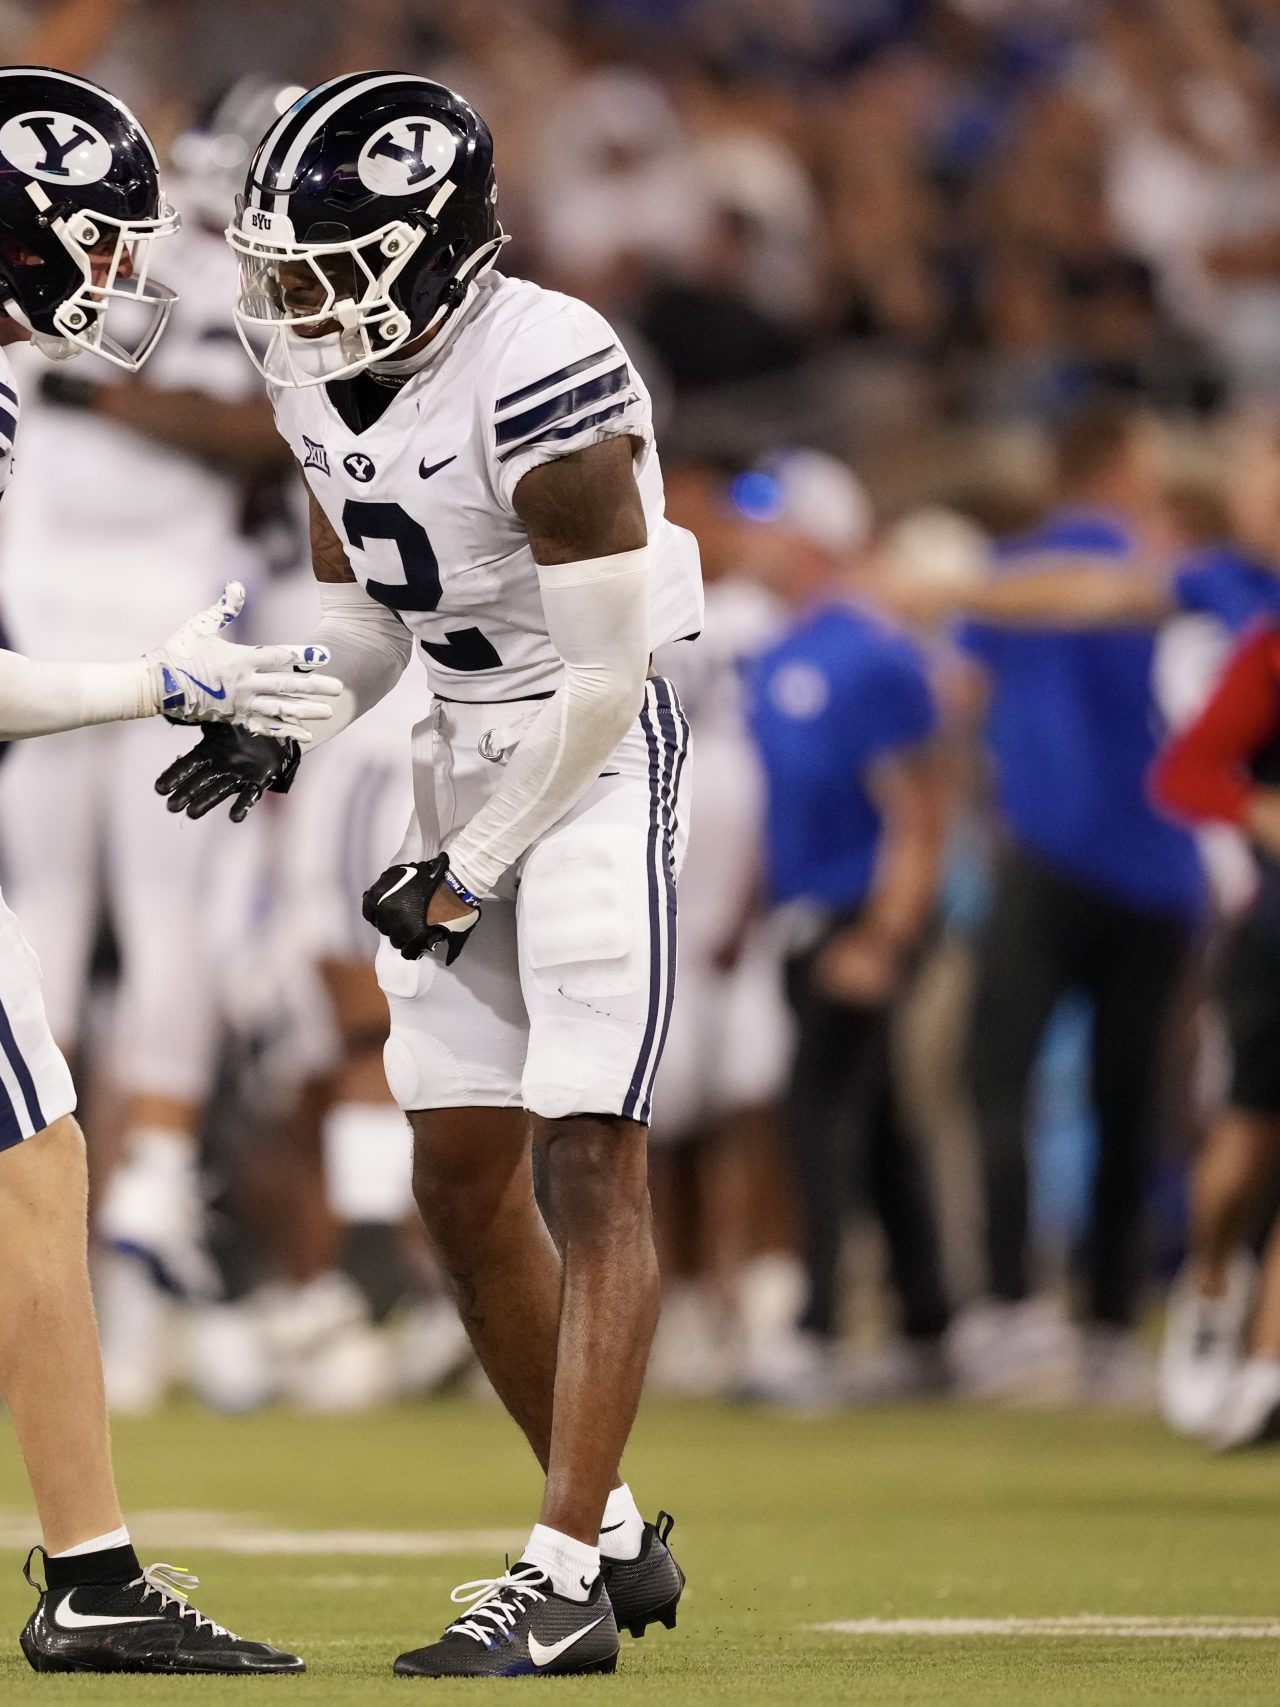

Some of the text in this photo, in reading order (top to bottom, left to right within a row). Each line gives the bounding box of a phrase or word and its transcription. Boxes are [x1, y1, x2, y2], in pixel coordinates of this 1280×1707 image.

[19, 117, 97, 176] Y
[367, 123, 436, 186] Y
[252, 213, 271, 230] BYU
[346, 455, 371, 480] Y
[341, 498, 503, 671] 2
